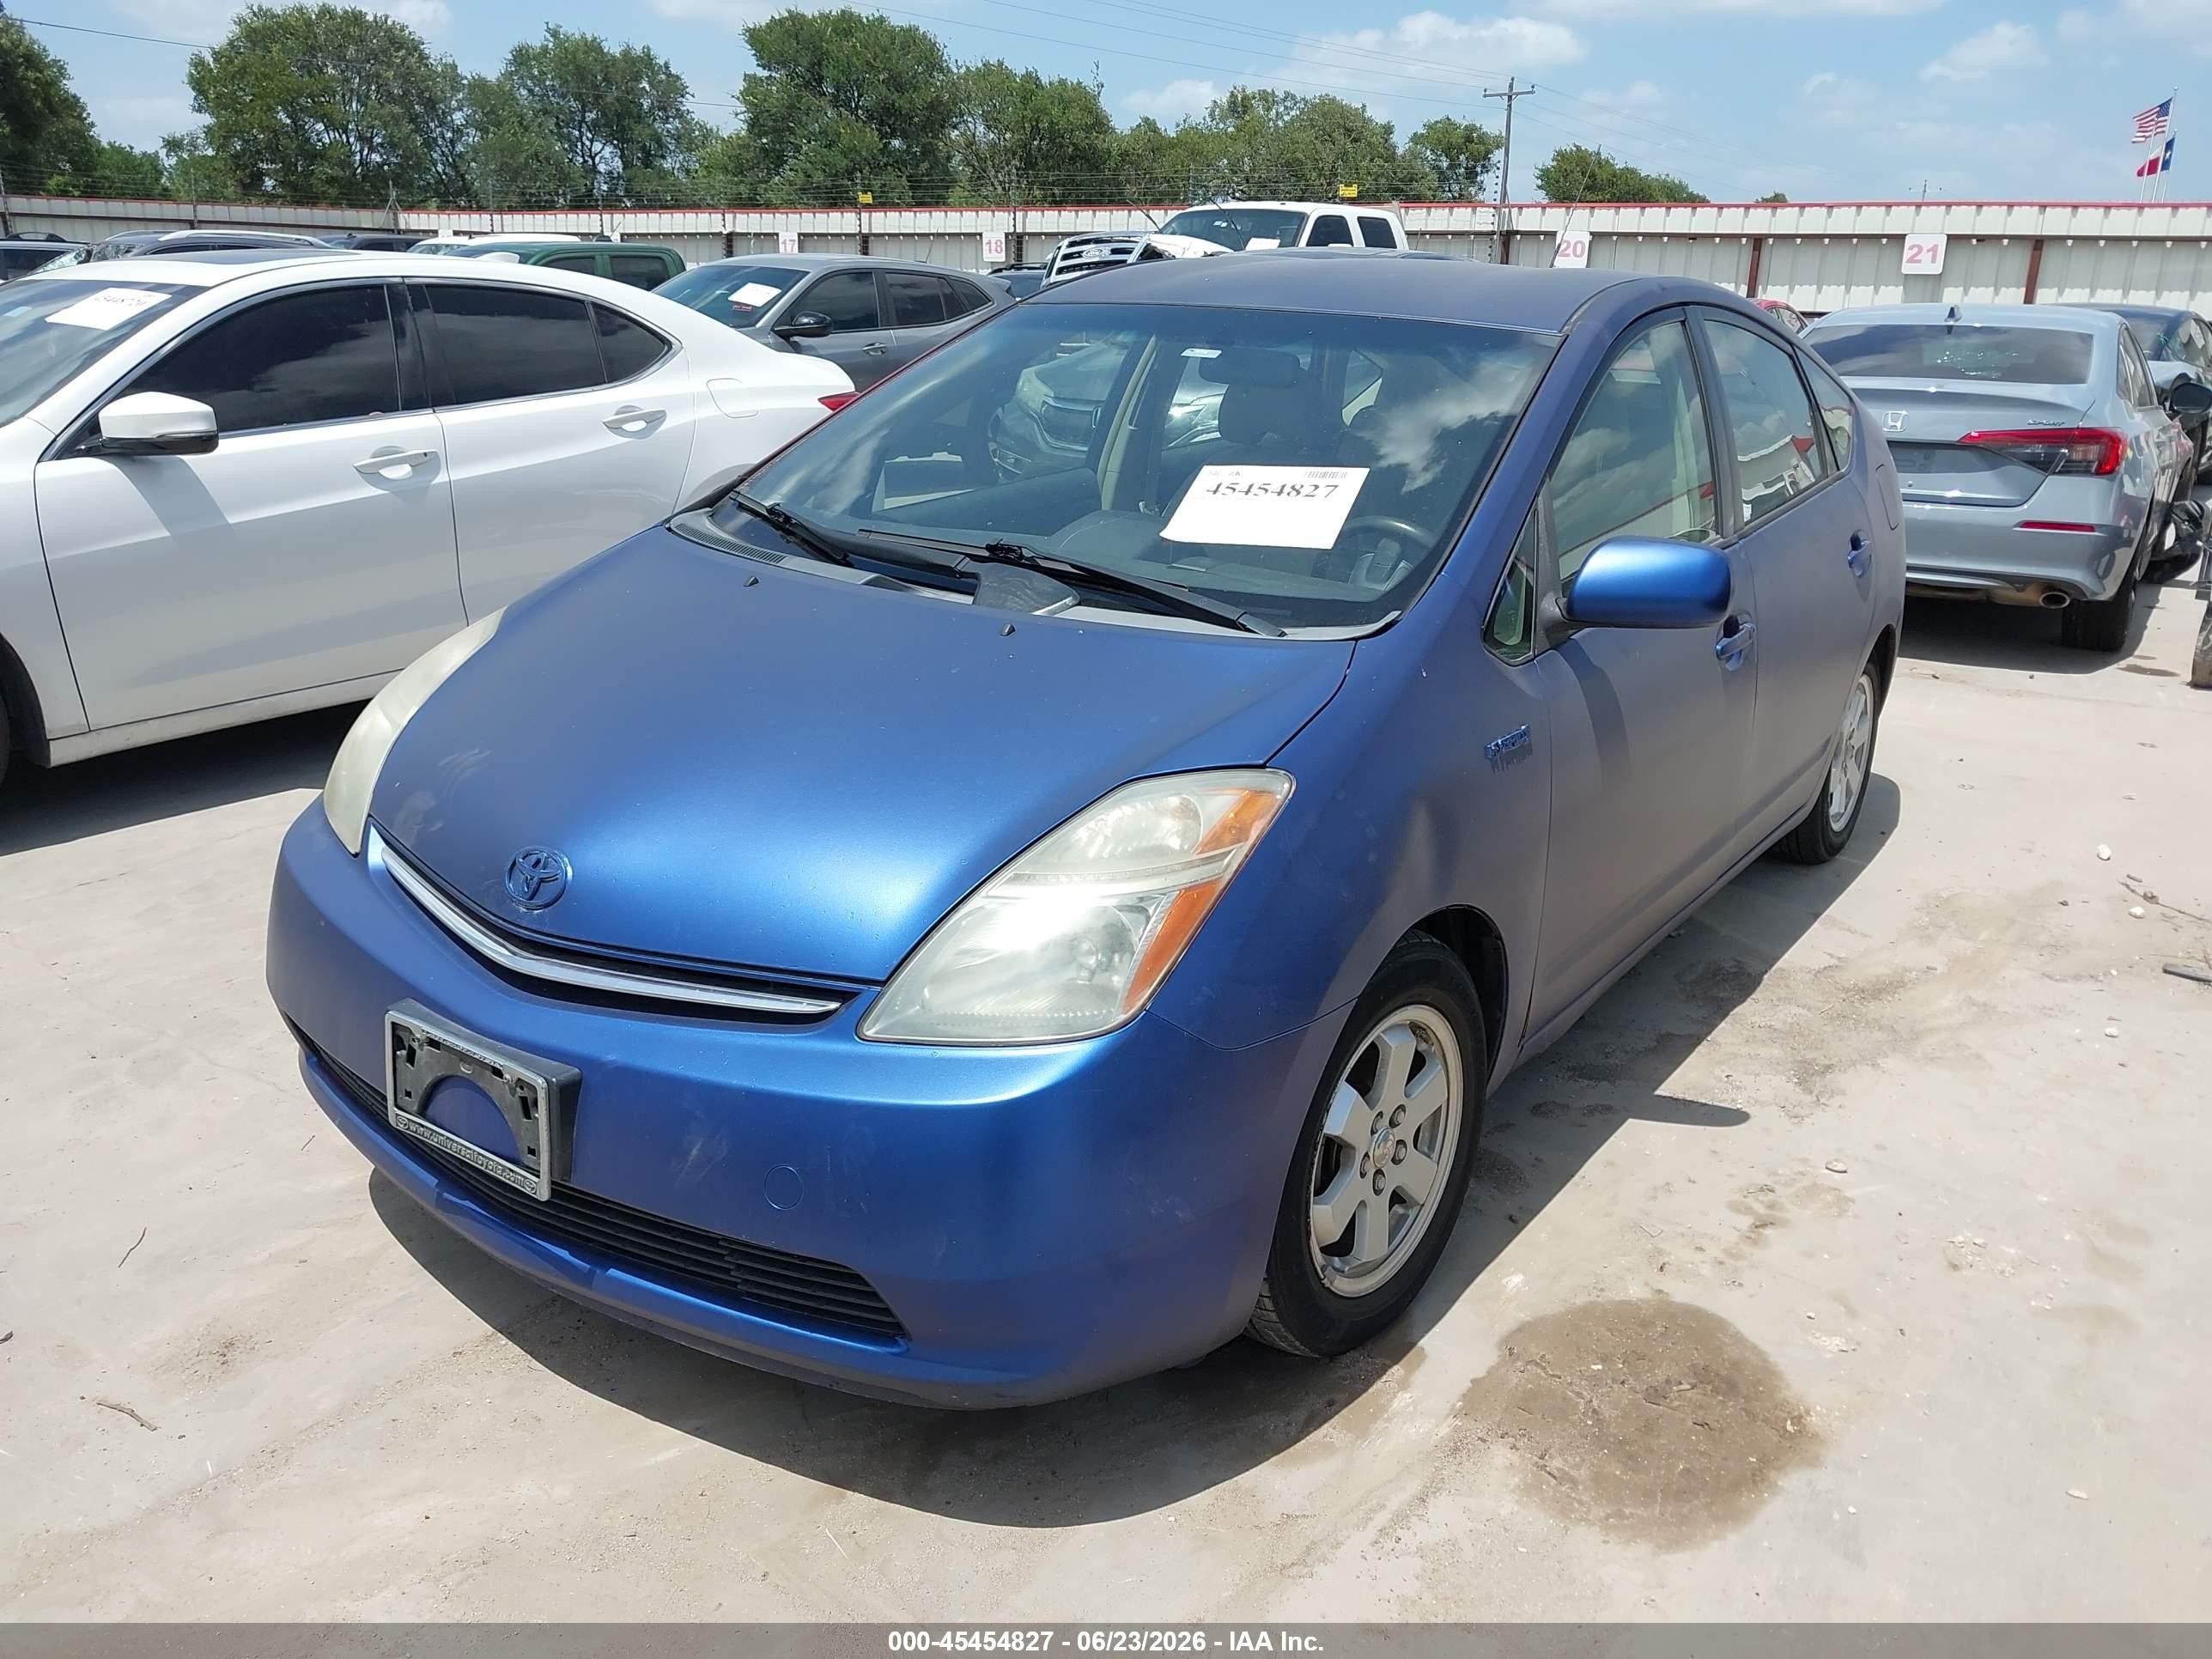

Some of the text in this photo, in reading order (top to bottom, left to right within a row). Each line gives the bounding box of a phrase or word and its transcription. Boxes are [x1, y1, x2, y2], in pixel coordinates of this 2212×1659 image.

[781, 239, 797, 253] 17
[985, 239, 1004, 254] 18
[1558, 240, 1586, 258] 20
[1905, 244, 1940, 264] 21
[1206, 482, 1340, 498] 45454827
[409, 1121, 524, 1187] www.universaltoyota.com
